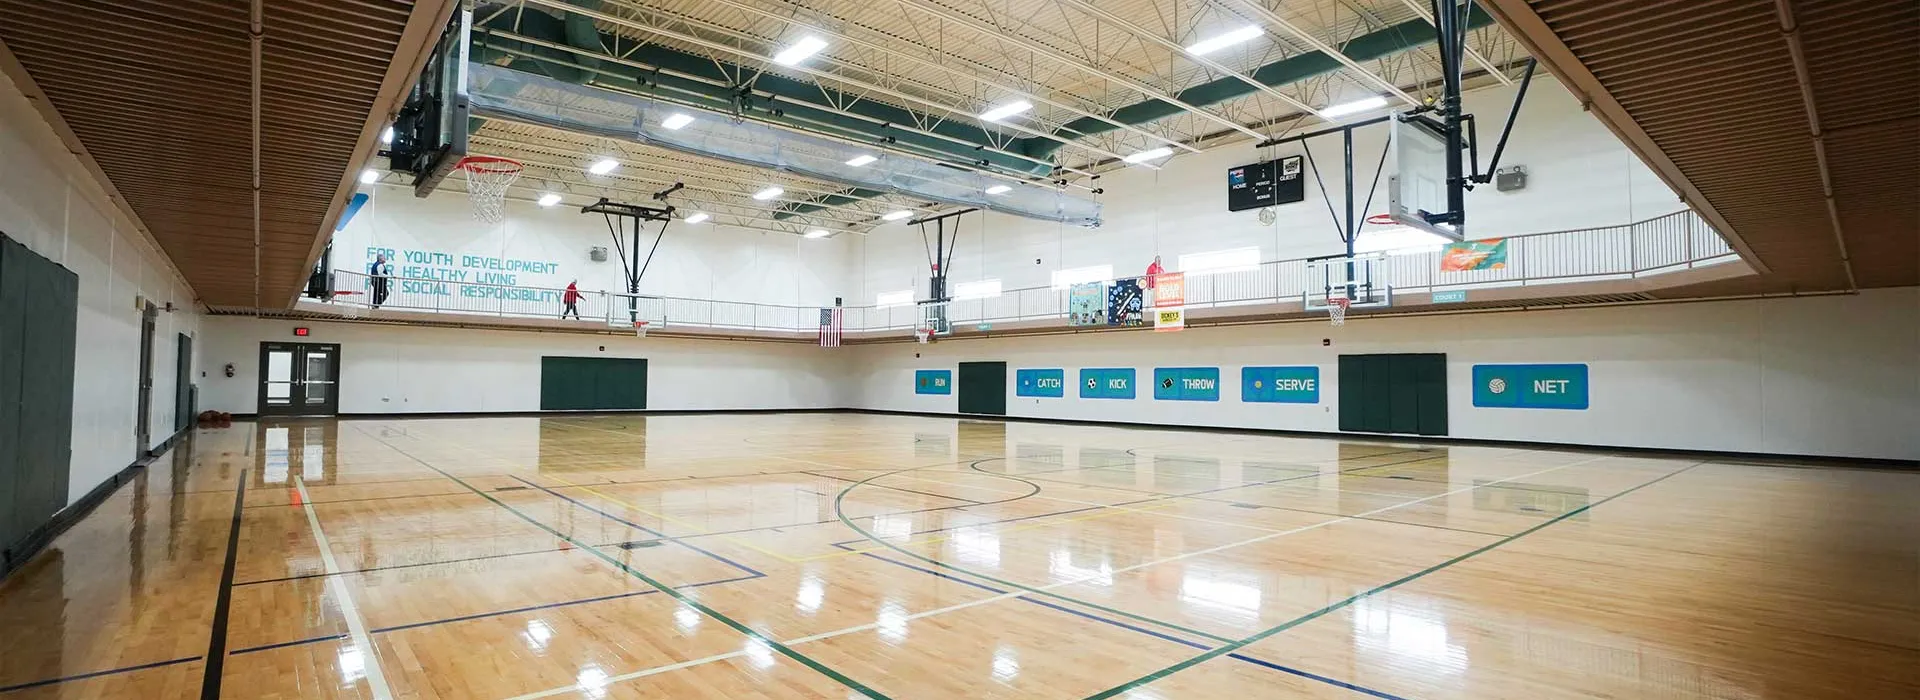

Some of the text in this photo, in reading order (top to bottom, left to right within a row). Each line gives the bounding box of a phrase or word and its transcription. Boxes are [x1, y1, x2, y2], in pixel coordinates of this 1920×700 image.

[403, 250, 453, 266] YOUTH
[463, 255, 559, 274] DEVELOPMENT
[366, 263, 516, 286] FR HEALTHY LIVING
[402, 280, 451, 296] SOCIAL
[460, 286, 562, 303] RESPONSIBILITY
[935, 378, 946, 387] RUN
[1037, 378, 1061, 389] CATCH
[1109, 378, 1127, 390] KICK
[1183, 378, 1215, 390] THROW
[1275, 378, 1315, 392] SERVE
[1533, 379, 1569, 394] NET
